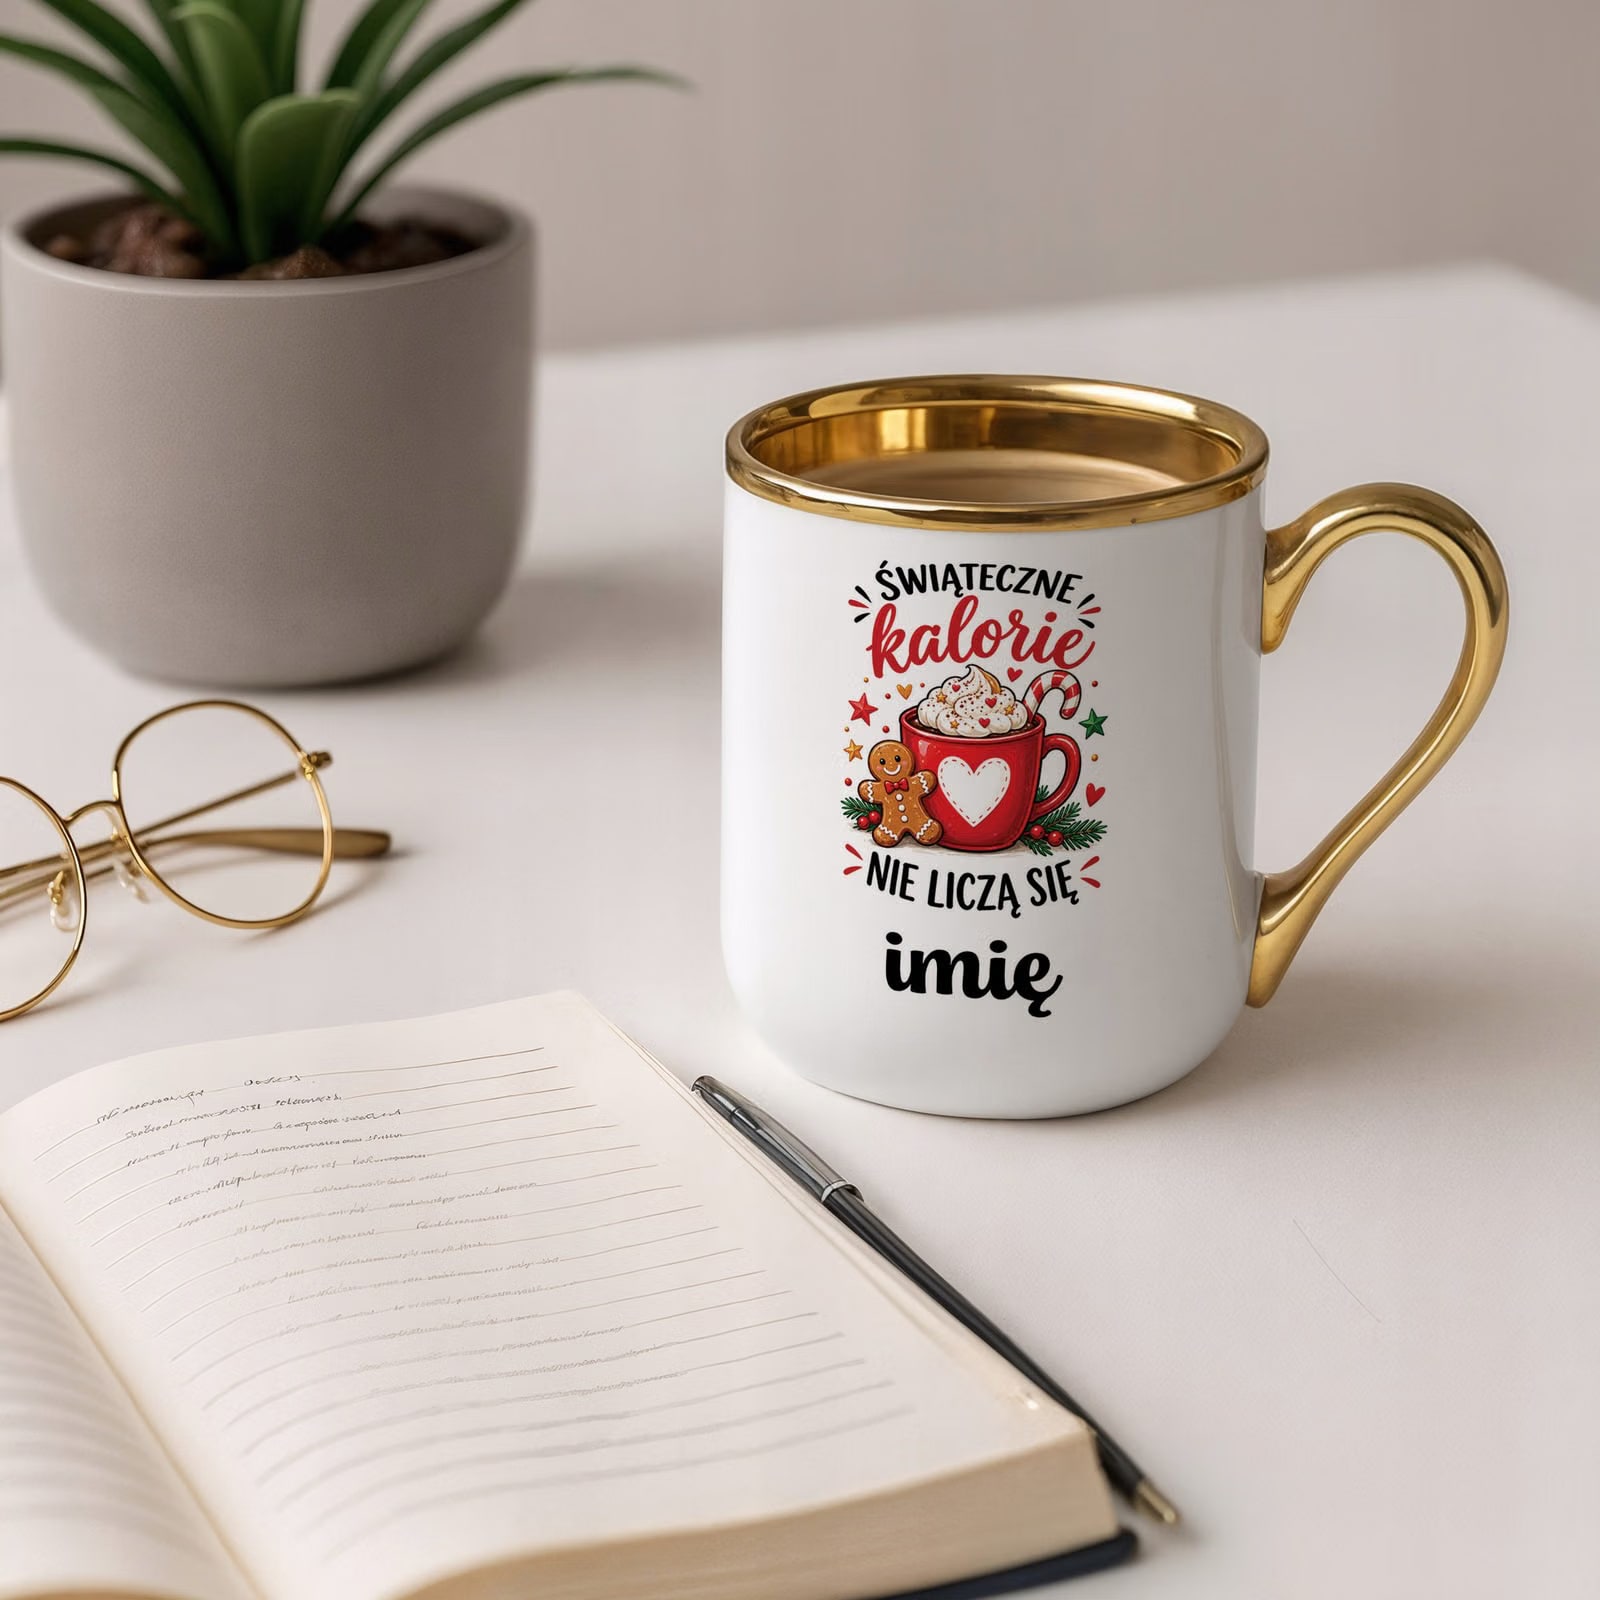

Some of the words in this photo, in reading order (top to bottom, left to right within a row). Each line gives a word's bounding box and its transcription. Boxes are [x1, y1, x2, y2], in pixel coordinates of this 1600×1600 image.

[875, 560, 1083, 604] ŚWIĄTECZNE
[866, 595, 1096, 679] kalorie
[866, 851, 919, 902] NIE
[927, 869, 1021, 919] LICZĄ
[1026, 859, 1080, 905] SIĘ
[885, 931, 1064, 1018] imię
